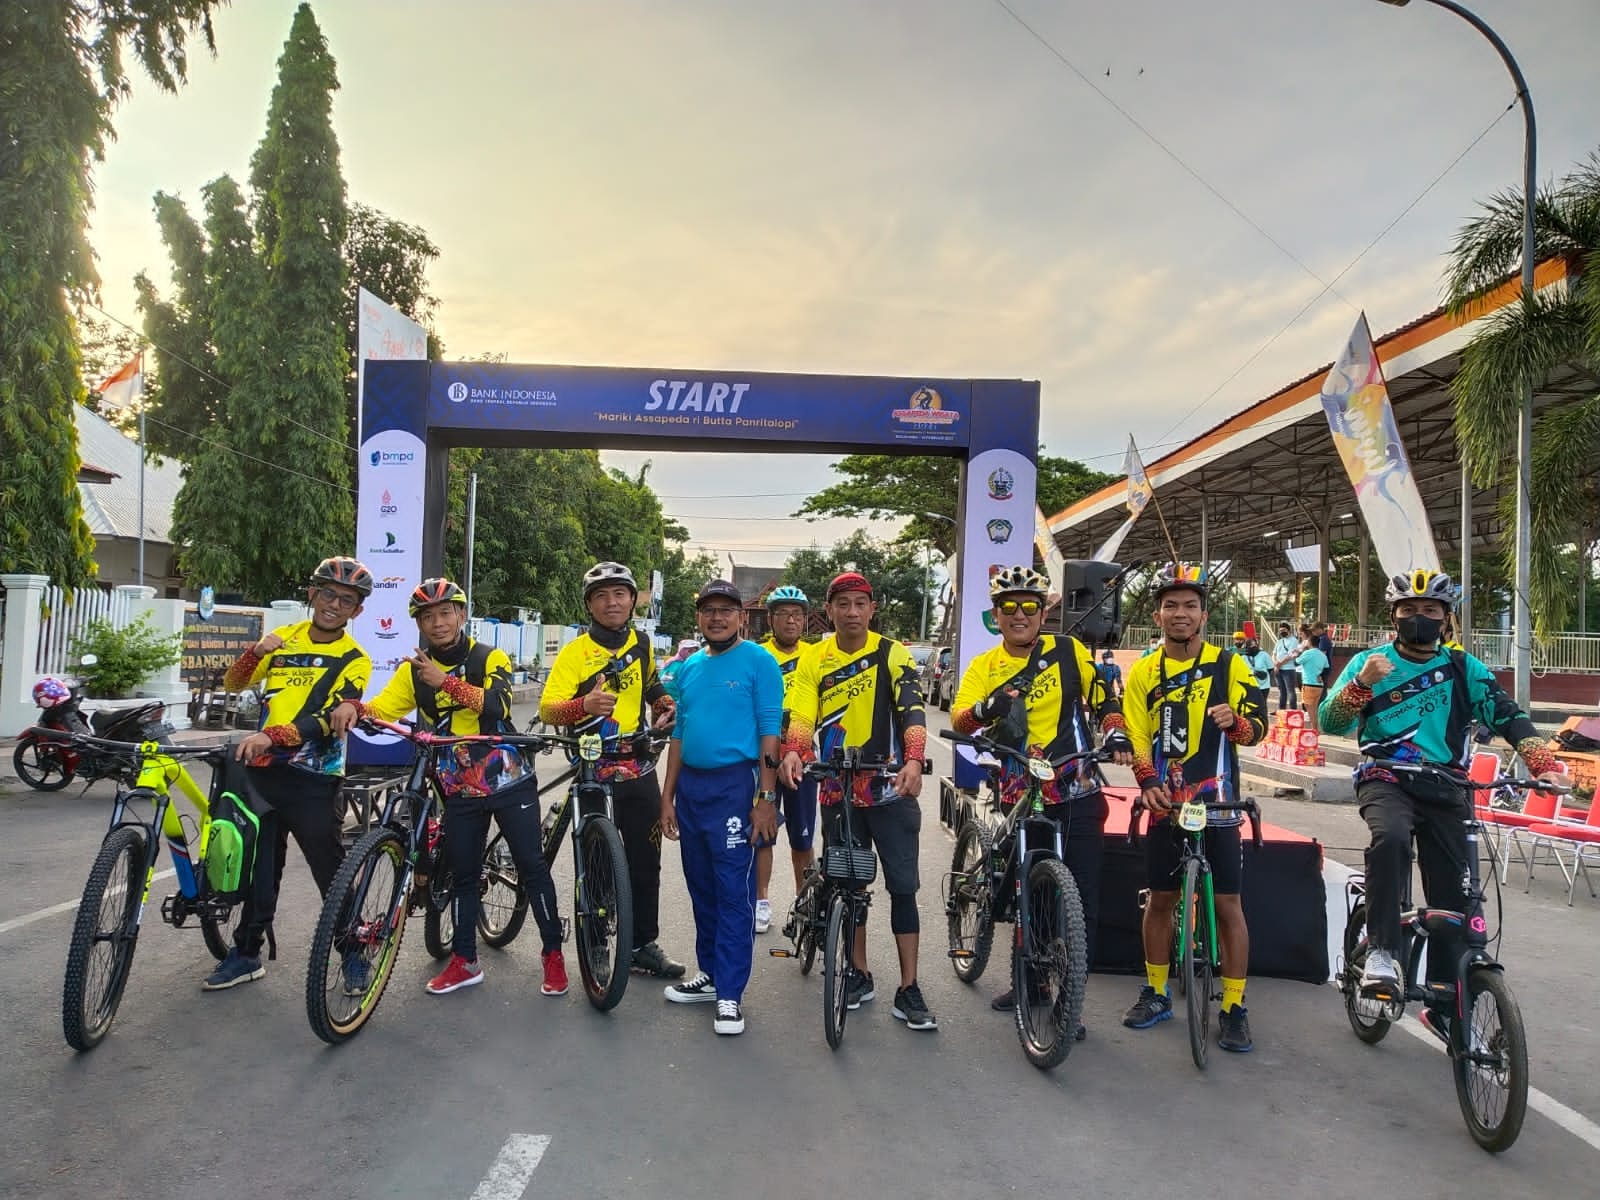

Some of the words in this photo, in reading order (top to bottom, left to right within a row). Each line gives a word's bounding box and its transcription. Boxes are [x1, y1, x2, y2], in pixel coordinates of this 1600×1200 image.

[471, 388, 497, 399] BANK
[501, 389, 557, 401] INDONESIA
[644, 379, 750, 413] START
[634, 413, 690, 425] Assapeda
[692, 414, 700, 424] ri
[703, 416, 732, 426] Butta
[382, 452, 414, 461] bmpd
[181, 654, 236, 669] SBANGPO
[286, 676, 314, 687] 2022
[847, 679, 873, 700] 2022
[1029, 677, 1058, 703] 2022
[1416, 694, 1449, 717] 2022
[1163, 706, 1172, 753] CONVERSE
